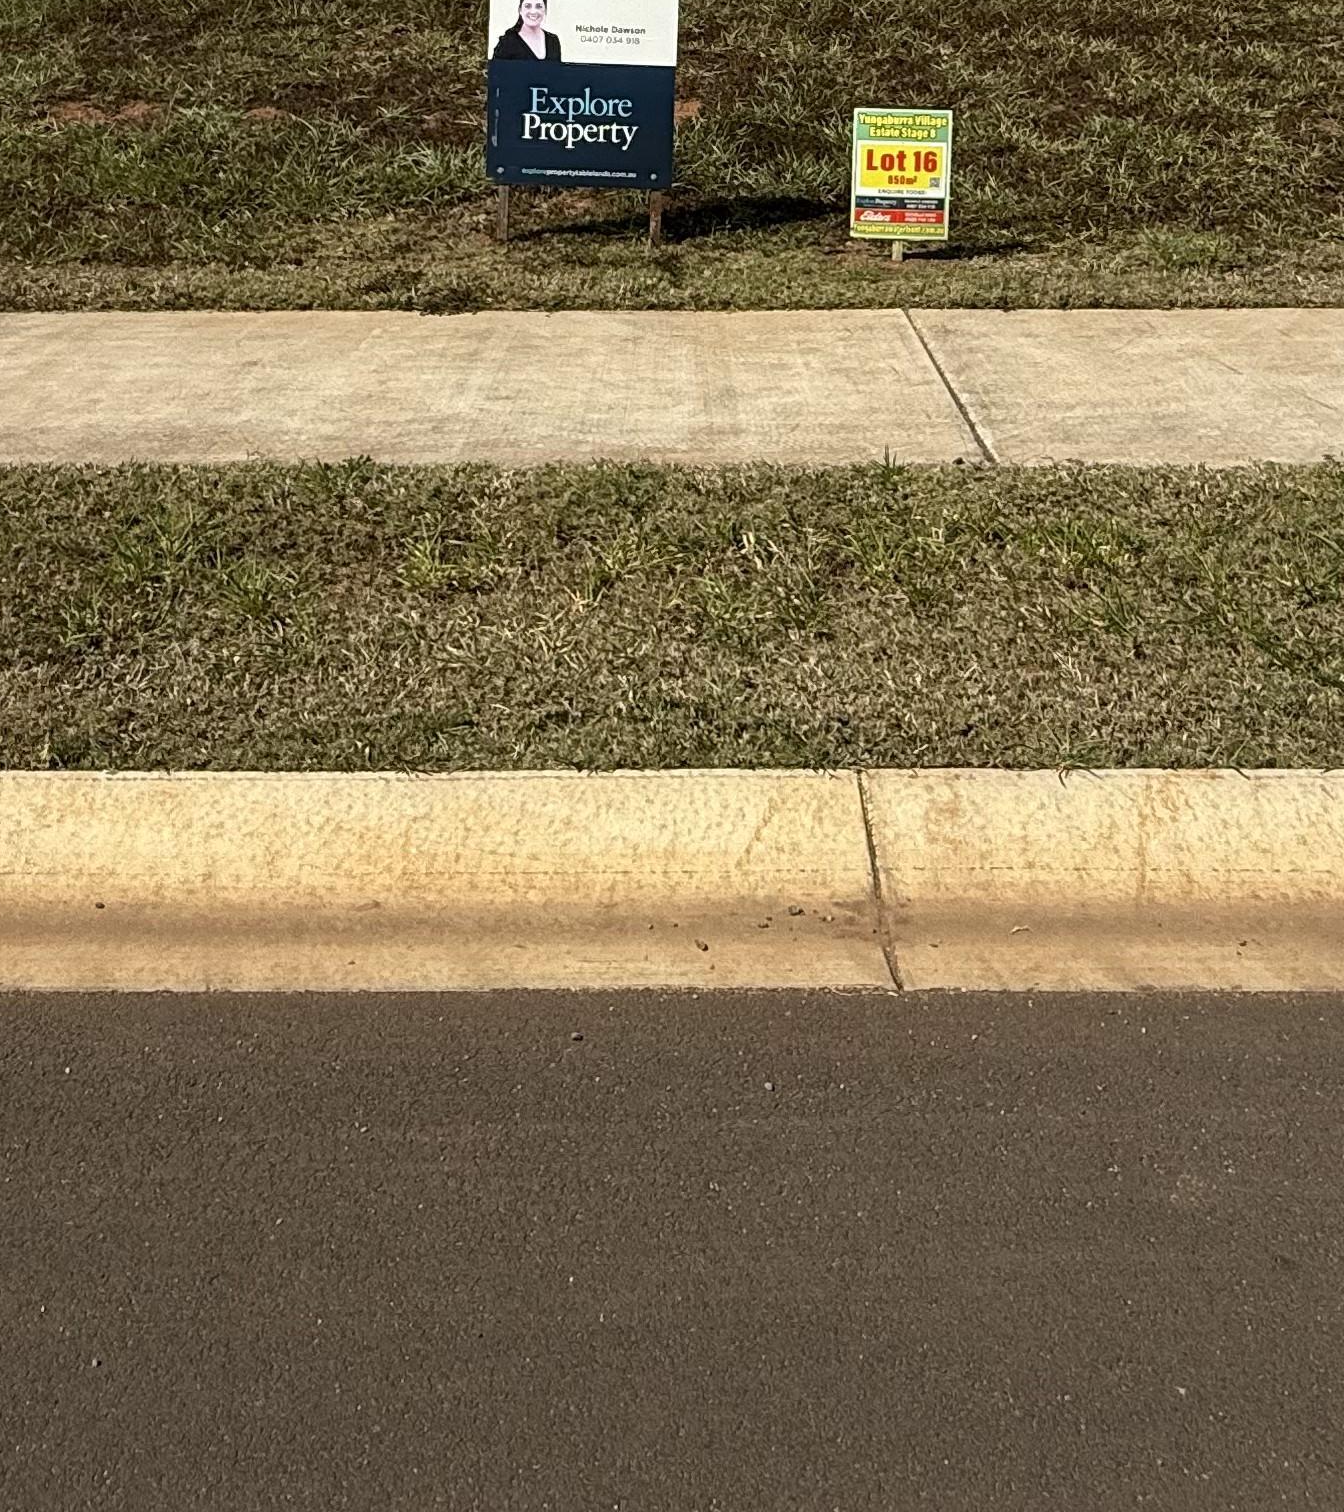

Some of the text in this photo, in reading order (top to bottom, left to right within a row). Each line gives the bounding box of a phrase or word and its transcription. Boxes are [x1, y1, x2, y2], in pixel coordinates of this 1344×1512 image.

[580, 35, 604, 44] 0407
[529, 87, 633, 122] Explore
[914, 115, 948, 128] Village
[521, 113, 639, 151] Property
[869, 126, 900, 137] Estate
[901, 127, 929, 140] Stage
[866, 149, 938, 173] Lot 16
